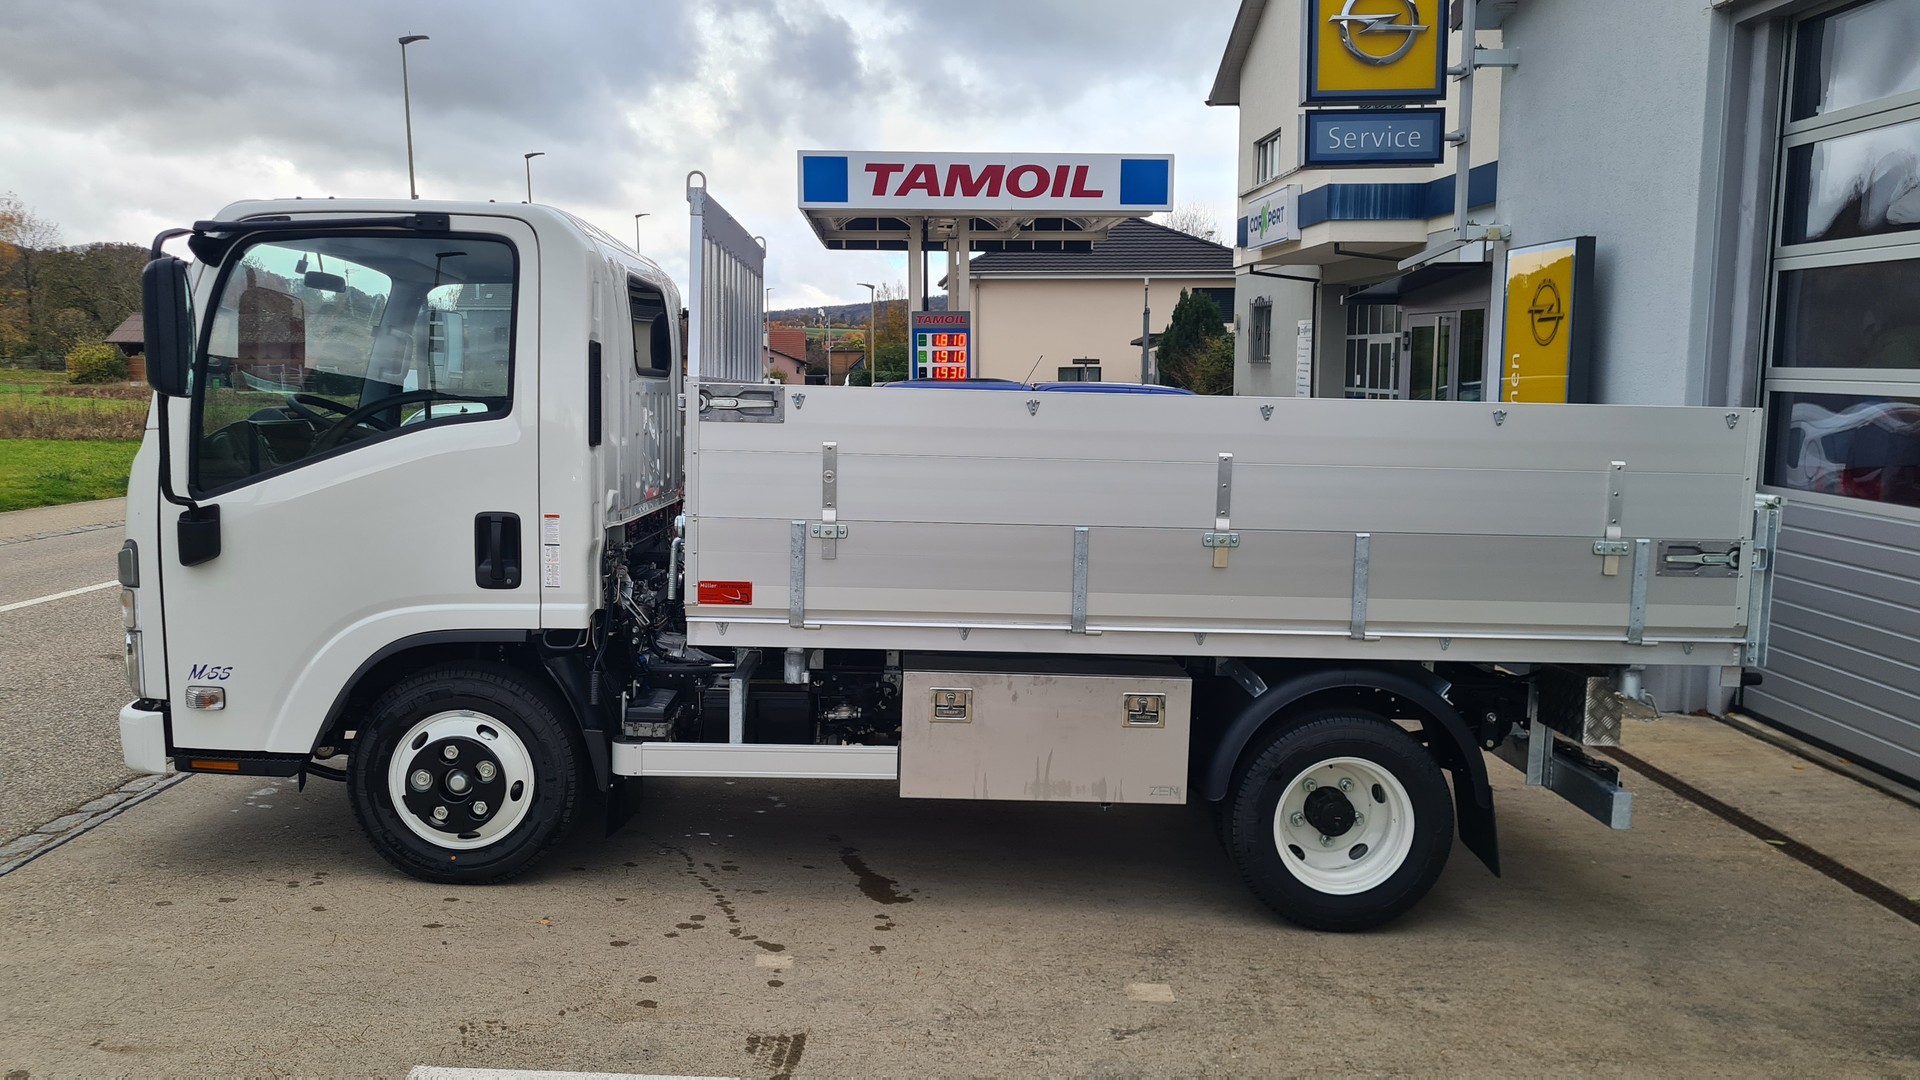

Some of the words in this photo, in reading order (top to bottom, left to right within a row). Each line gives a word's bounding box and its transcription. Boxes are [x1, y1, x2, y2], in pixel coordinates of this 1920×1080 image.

[1328, 125, 1422, 149] Service
[864, 162, 1104, 199] TAMOIL
[916, 315, 967, 325] TAMOIL
